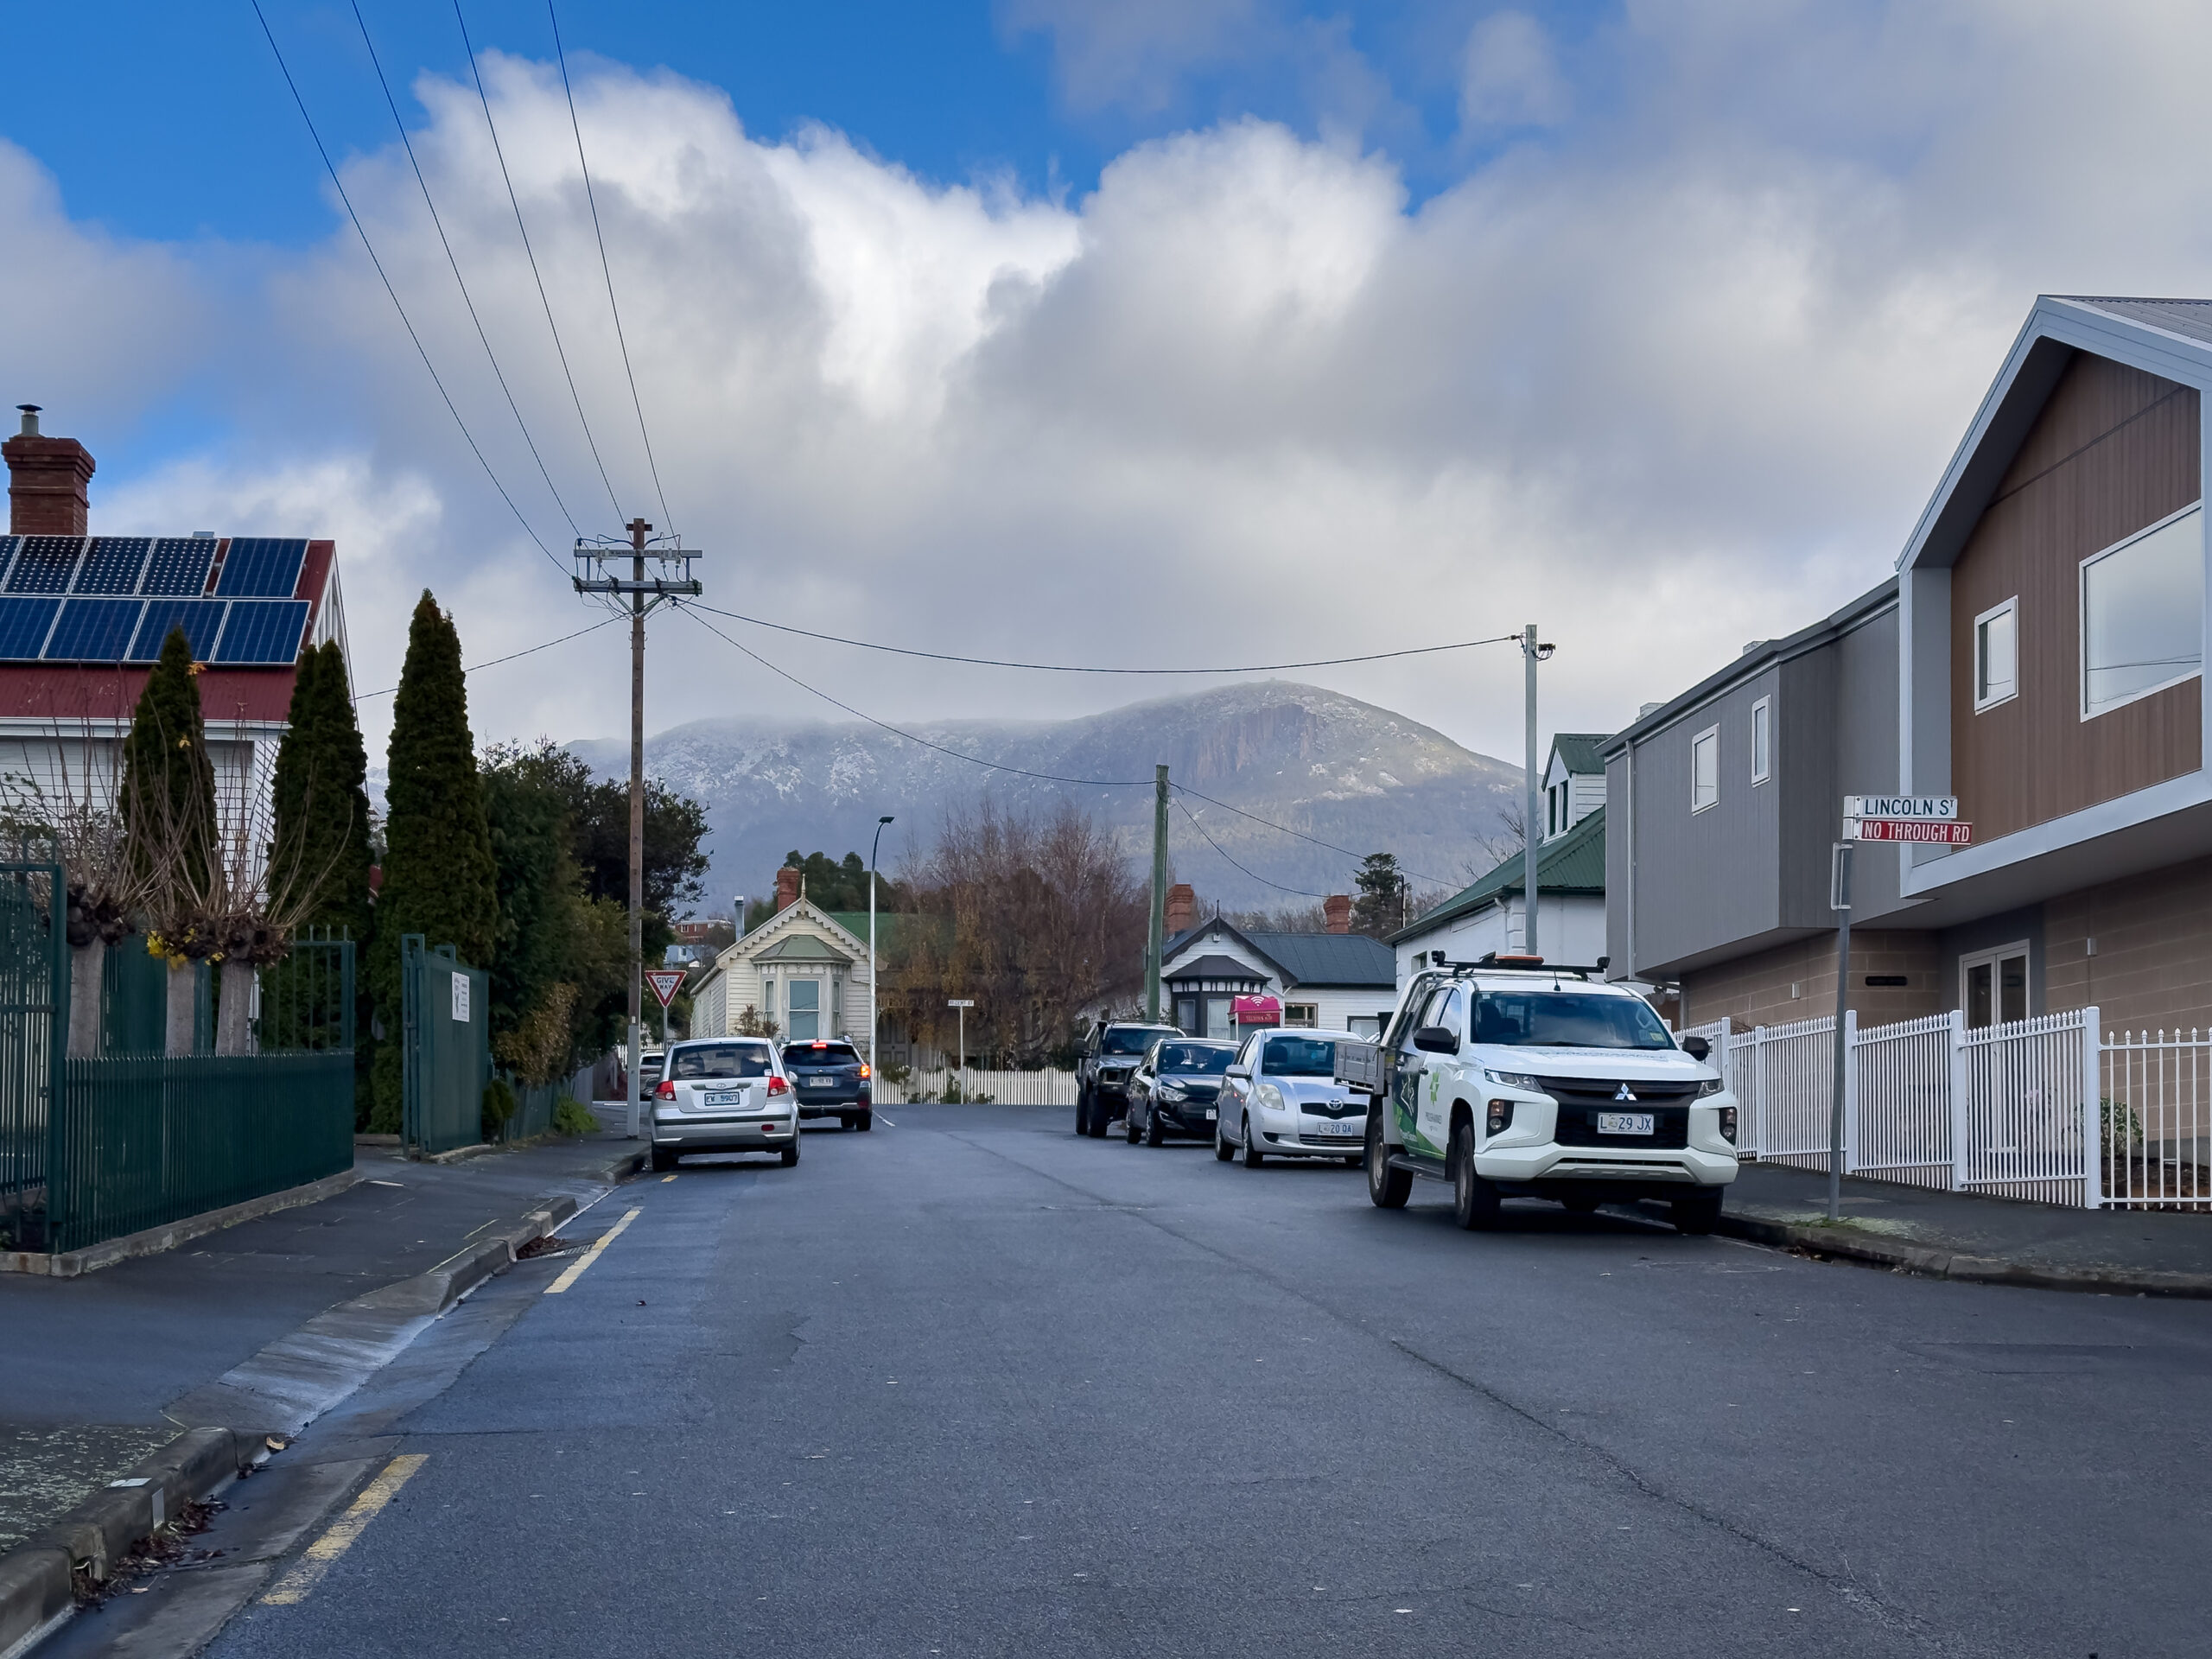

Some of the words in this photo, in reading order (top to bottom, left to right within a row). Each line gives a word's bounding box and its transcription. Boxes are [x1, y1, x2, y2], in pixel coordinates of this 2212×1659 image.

[1866, 799, 1933, 816] LINCOLN
[1865, 822, 1881, 839] NO
[1888, 823, 1948, 842] THROUGH
[1953, 826, 1969, 842] RD
[1331, 1124, 1340, 1134] 20
[1600, 1116, 1607, 1128] L
[1619, 1117, 1632, 1129] 29
[1637, 1116, 1650, 1130] JX
